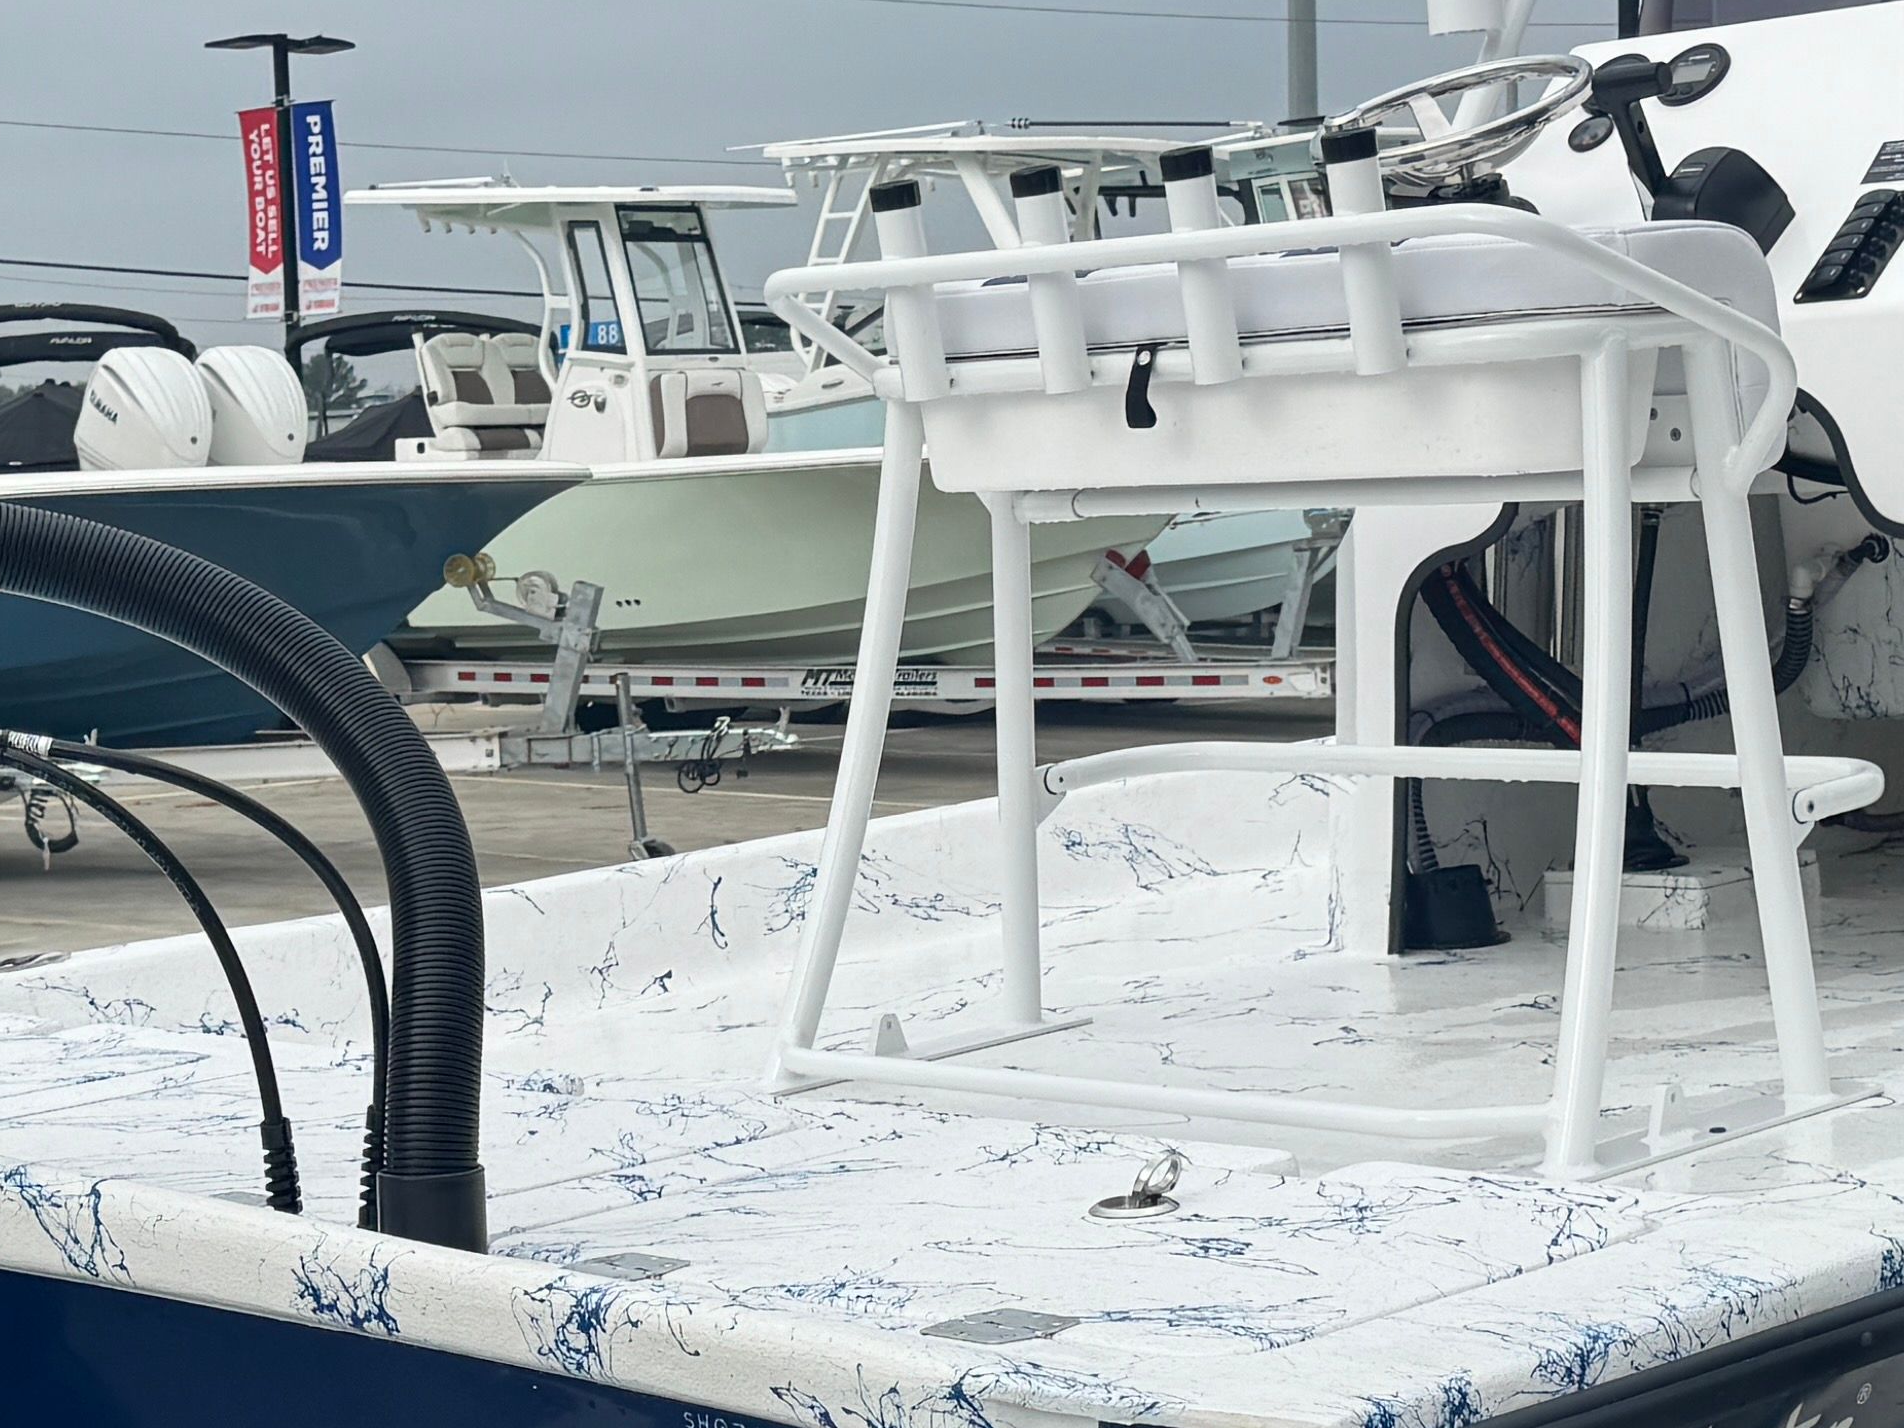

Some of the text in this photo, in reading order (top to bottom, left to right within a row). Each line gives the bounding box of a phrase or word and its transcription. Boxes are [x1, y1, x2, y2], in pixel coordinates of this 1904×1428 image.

[247, 128, 266, 257] YOUR BOAT
[260, 123, 279, 259] LET US SELL
[305, 114, 329, 252] PREMIER
